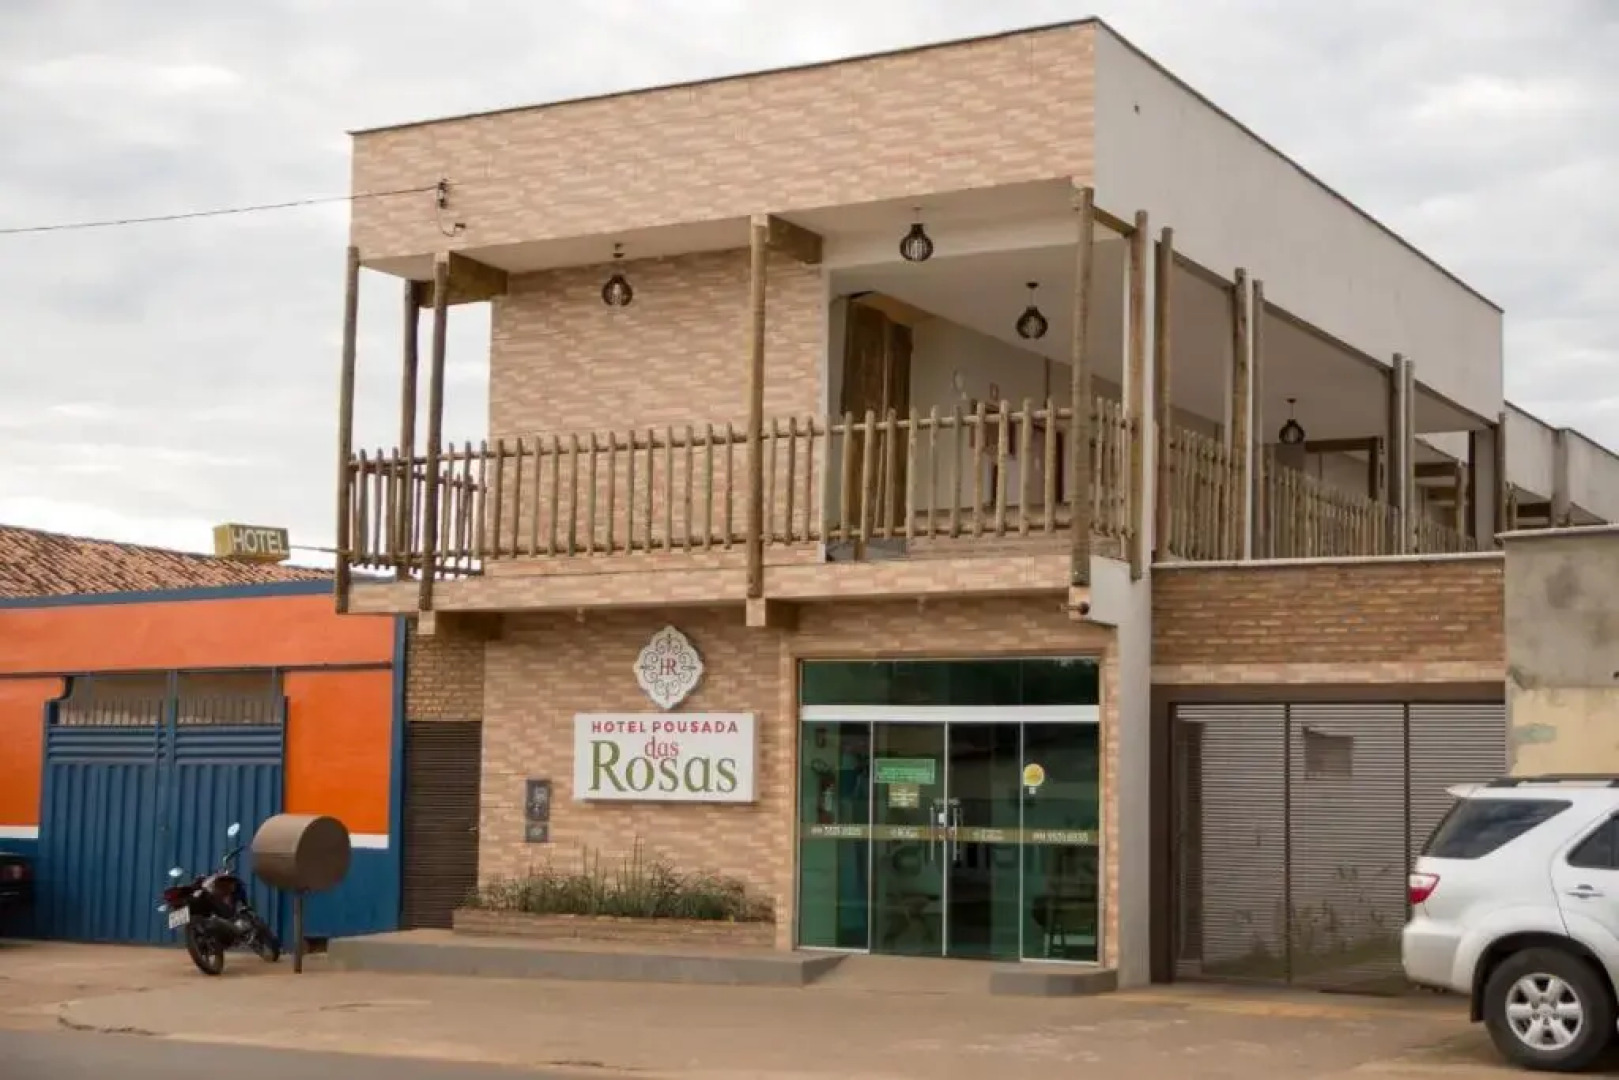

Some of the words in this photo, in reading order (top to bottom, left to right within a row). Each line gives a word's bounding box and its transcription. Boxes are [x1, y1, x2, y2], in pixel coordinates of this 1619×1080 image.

[232, 527, 289, 554] HOTEL
[592, 721, 646, 733] HOTEL
[652, 721, 738, 733] POUSADA
[644, 736, 679, 759] das
[589, 740, 737, 793] Rosas
